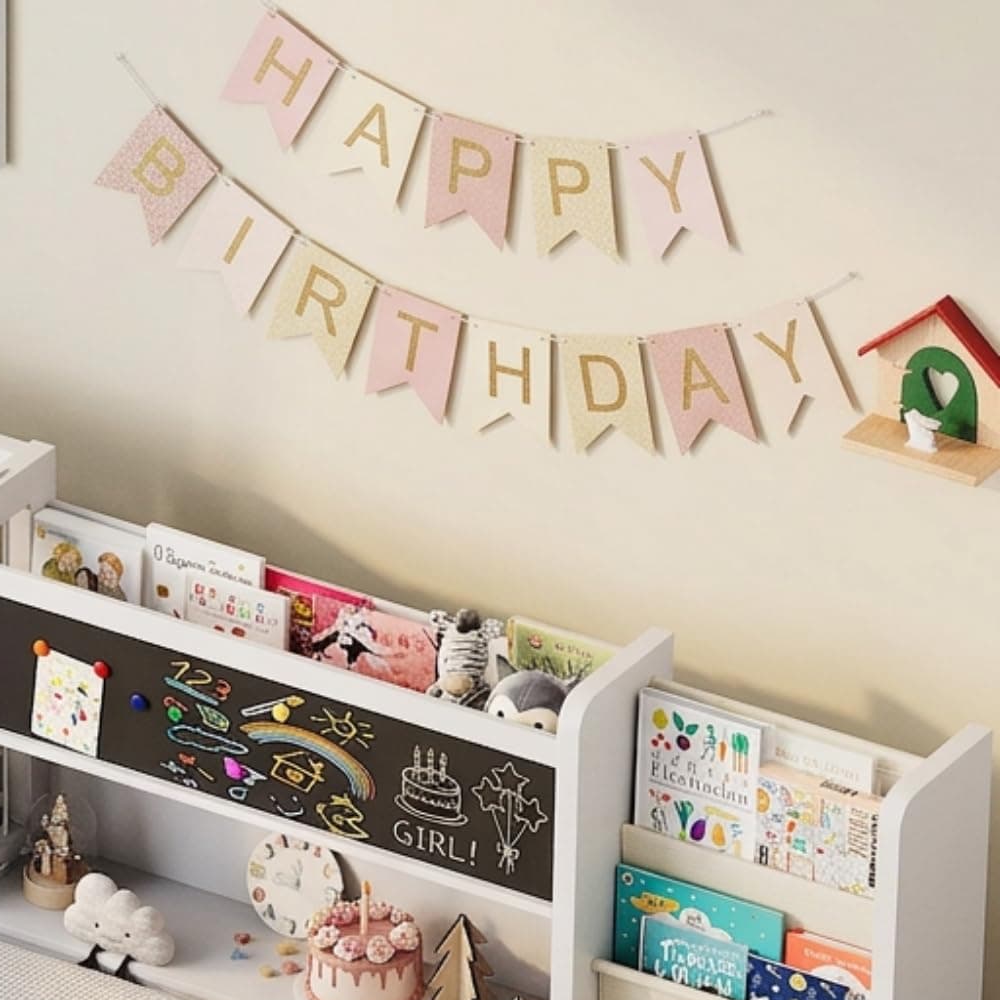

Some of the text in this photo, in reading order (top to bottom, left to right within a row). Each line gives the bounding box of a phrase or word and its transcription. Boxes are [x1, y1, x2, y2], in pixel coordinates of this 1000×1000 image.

[252, 35, 687, 218] HAPPY
[131, 134, 803, 414] BIRTHDAY
[393, 819, 477, 867] GIRL!
